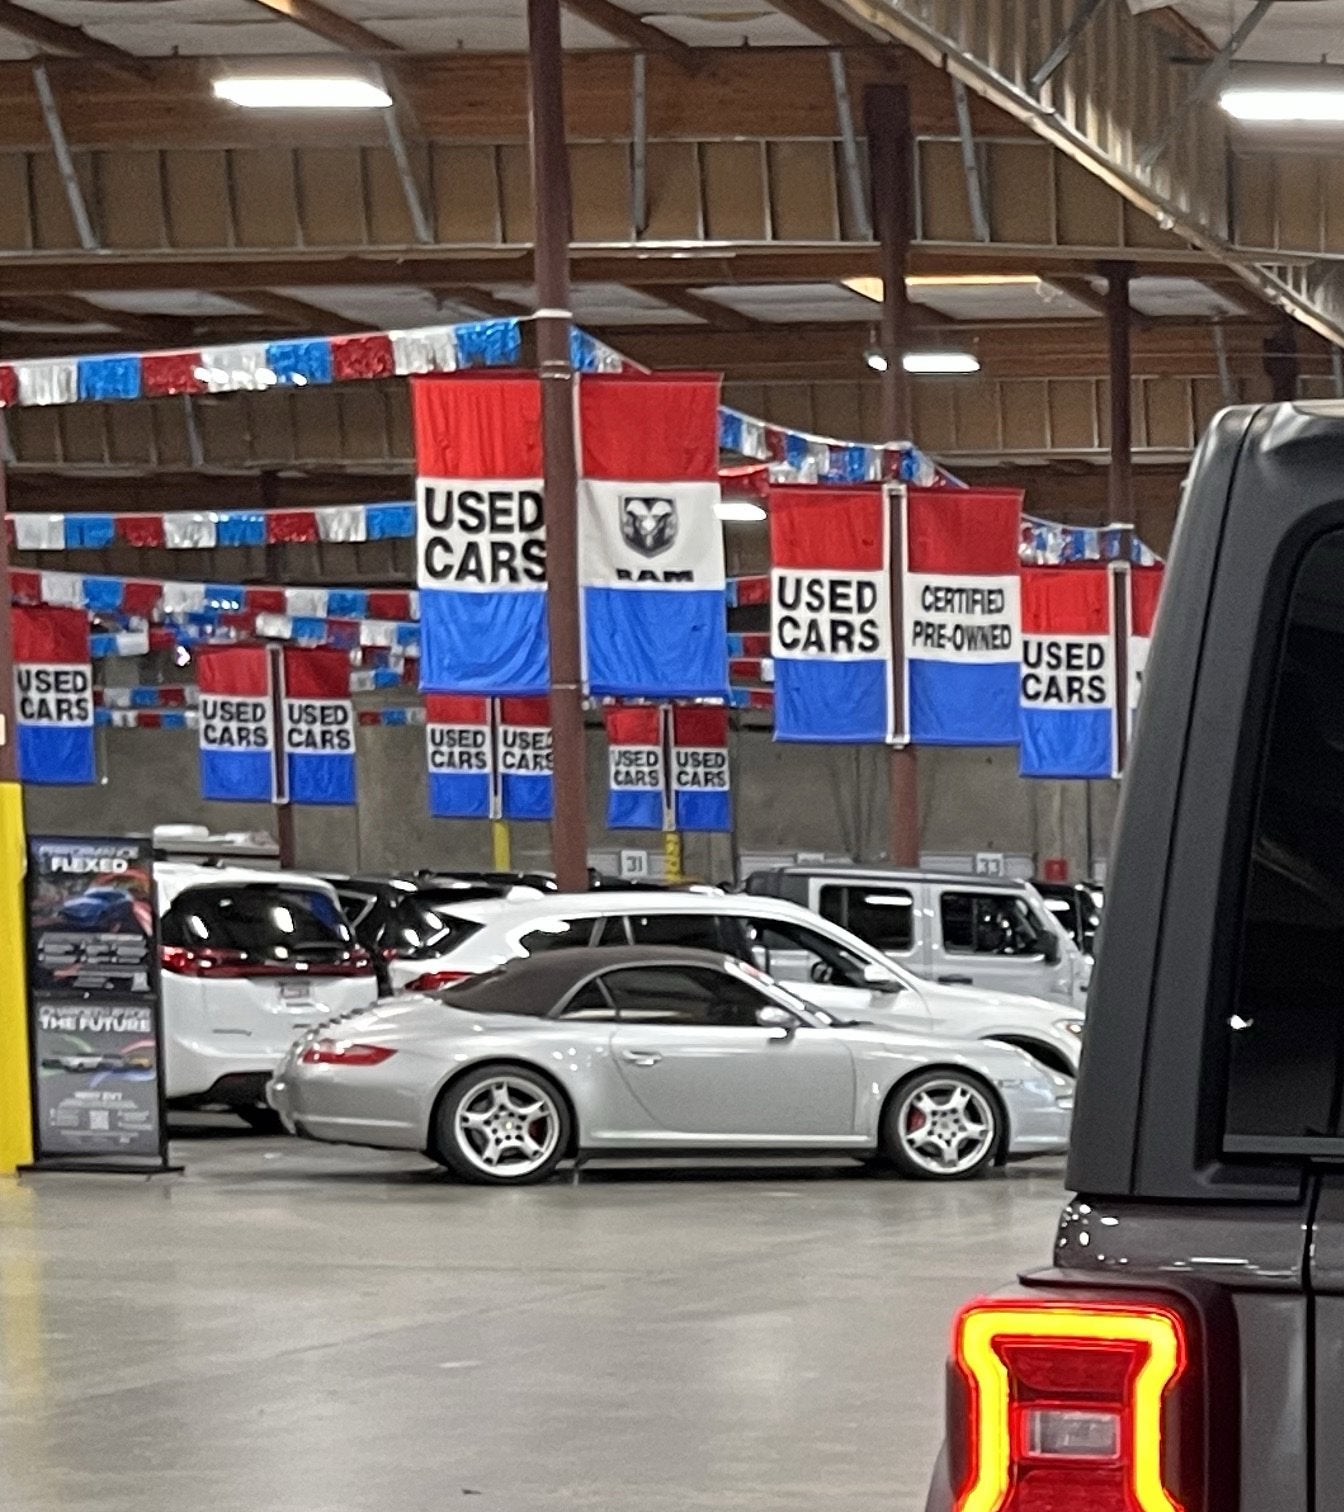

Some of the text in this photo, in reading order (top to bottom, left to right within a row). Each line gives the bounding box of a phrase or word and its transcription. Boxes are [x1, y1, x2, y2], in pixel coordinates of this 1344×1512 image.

[424, 486, 545, 534] USED
[424, 536, 547, 584] CARS
[615, 568, 695, 583] RAM
[777, 576, 878, 614] USED
[921, 584, 1005, 615] CERTIFIED
[777, 615, 881, 654] CARS
[912, 620, 1012, 651] PRE-OWNED
[1022, 640, 1106, 671] USED
[16, 669, 88, 694] USED
[1021, 673, 1107, 704] CARS
[19, 698, 89, 722] CARS
[202, 700, 267, 723] USED
[287, 703, 349, 726] USED
[203, 724, 269, 748] CARS
[287, 727, 351, 750] CARS
[430, 729, 486, 748] USED
[430, 750, 488, 770] CARS
[675, 751, 726, 769] USED
[613, 770, 661, 786] CARS
[675, 770, 727, 788] CARS
[51, 857, 129, 874] FLEXED
[625, 855, 643, 873] 31
[40, 1015, 151, 1033] THE FUTURE
